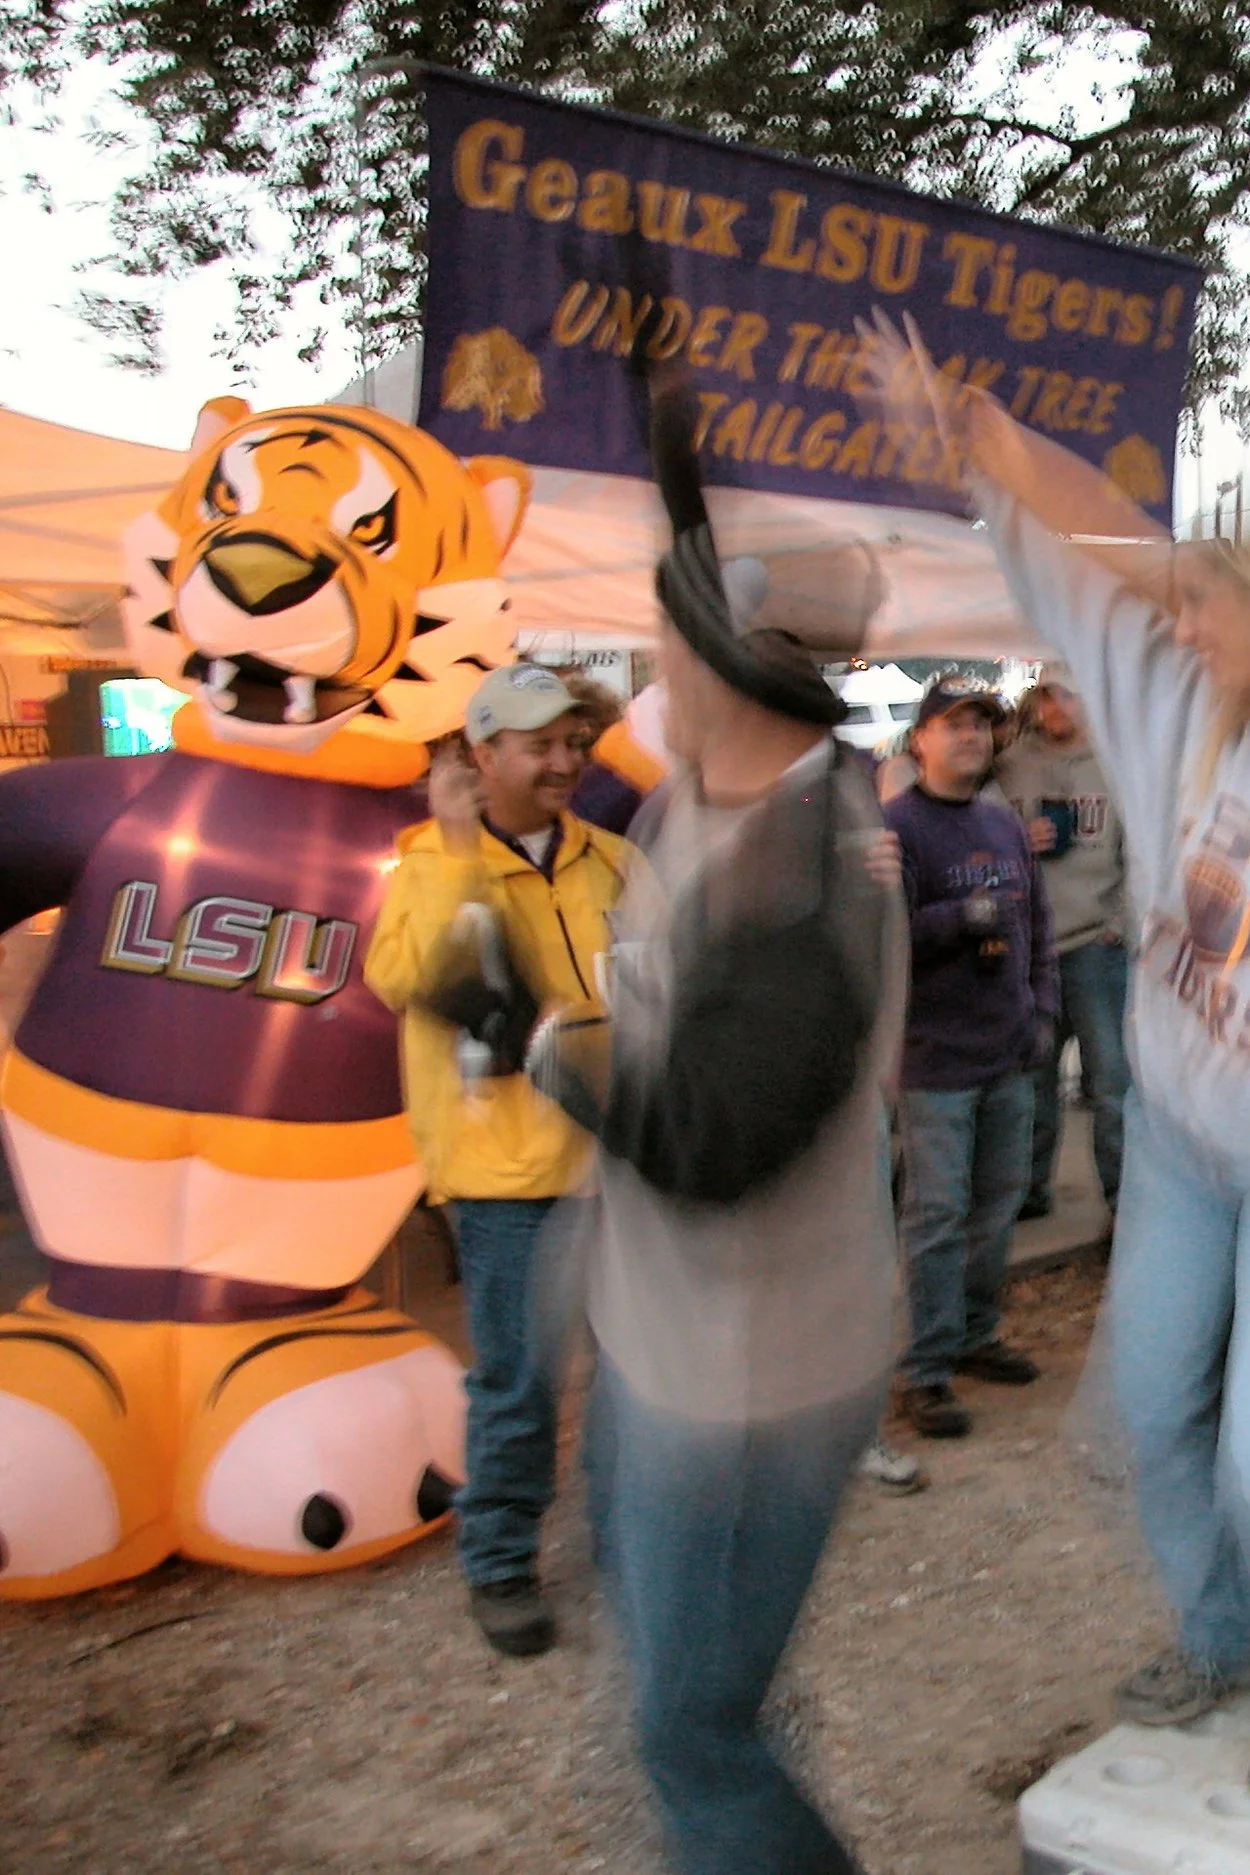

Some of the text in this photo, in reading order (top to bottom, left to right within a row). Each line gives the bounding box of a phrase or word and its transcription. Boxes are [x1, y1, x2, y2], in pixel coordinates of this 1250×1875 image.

[454, 118, 1184, 350] Geaux LSU Tigers!
[552, 279, 769, 381] UNDER
[777, 322, 885, 397] THE
[1012, 366, 1125, 434] TREE
[101, 880, 357, 1005] LSU
